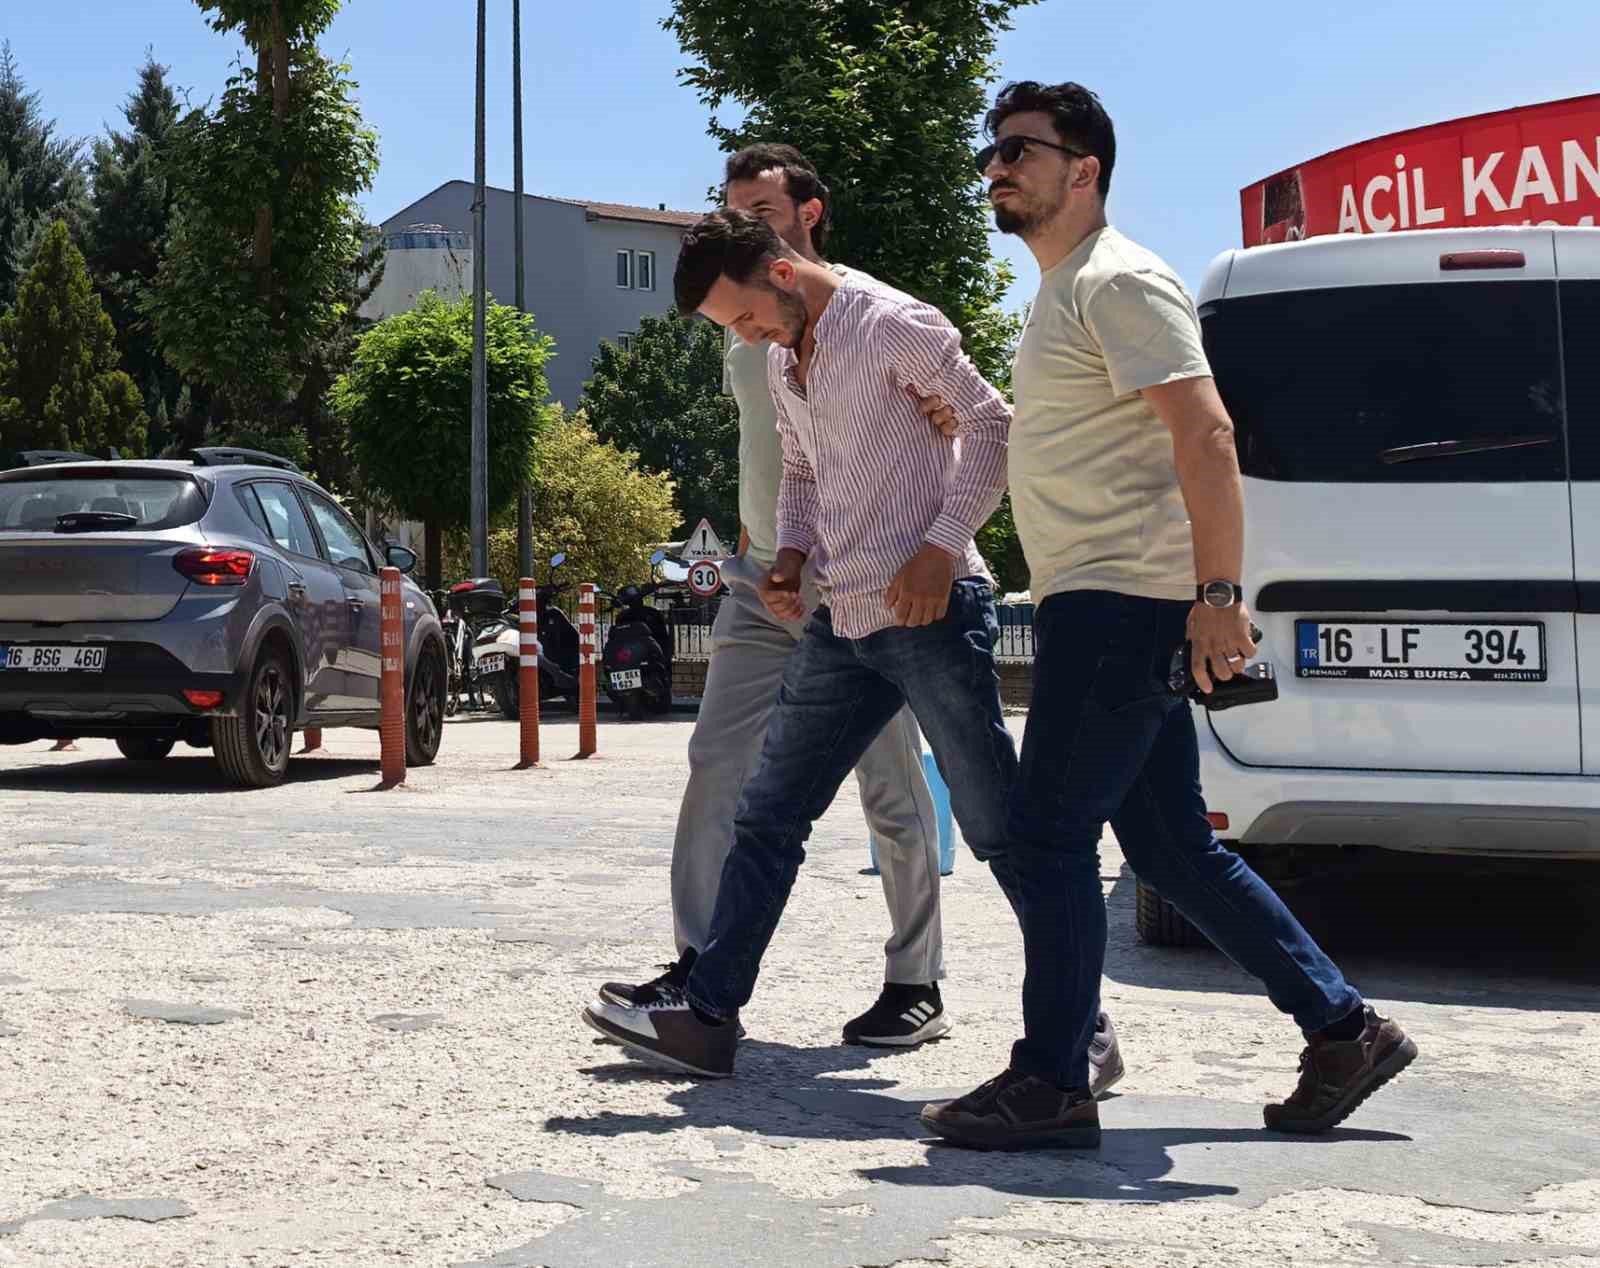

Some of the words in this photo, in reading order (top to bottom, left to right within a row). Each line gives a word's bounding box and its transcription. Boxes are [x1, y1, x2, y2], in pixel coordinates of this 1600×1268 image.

[1338, 153, 1444, 234] ACİL
[1461, 136, 1600, 216] KAN
[695, 570, 715, 585] 30
[1302, 648, 1318, 658] TR
[1320, 628, 1352, 662] 16
[1381, 628, 1420, 663] LF
[1464, 629, 1526, 665] 394
[7, 648, 22, 665] 16
[33, 648, 61, 665] BSG
[74, 649, 102, 666] 460
[1415, 669, 1471, 679] BURSA
